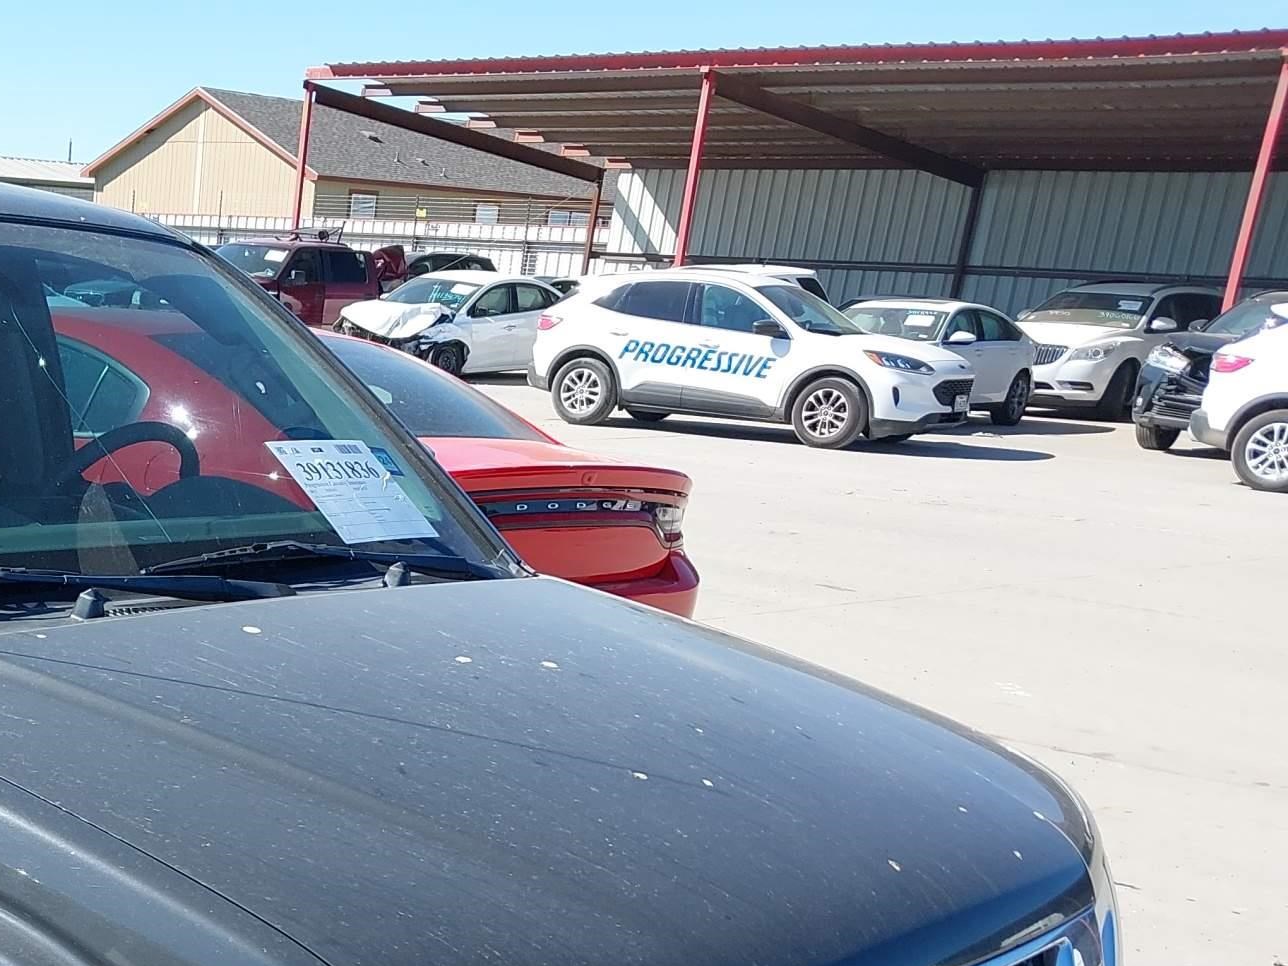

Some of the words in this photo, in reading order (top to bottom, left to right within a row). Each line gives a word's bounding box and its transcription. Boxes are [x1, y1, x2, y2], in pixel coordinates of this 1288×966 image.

[618, 339, 777, 379] PROGRESSIVE
[296, 460, 380, 481] 39131836
[516, 502, 637, 511] DODGE
